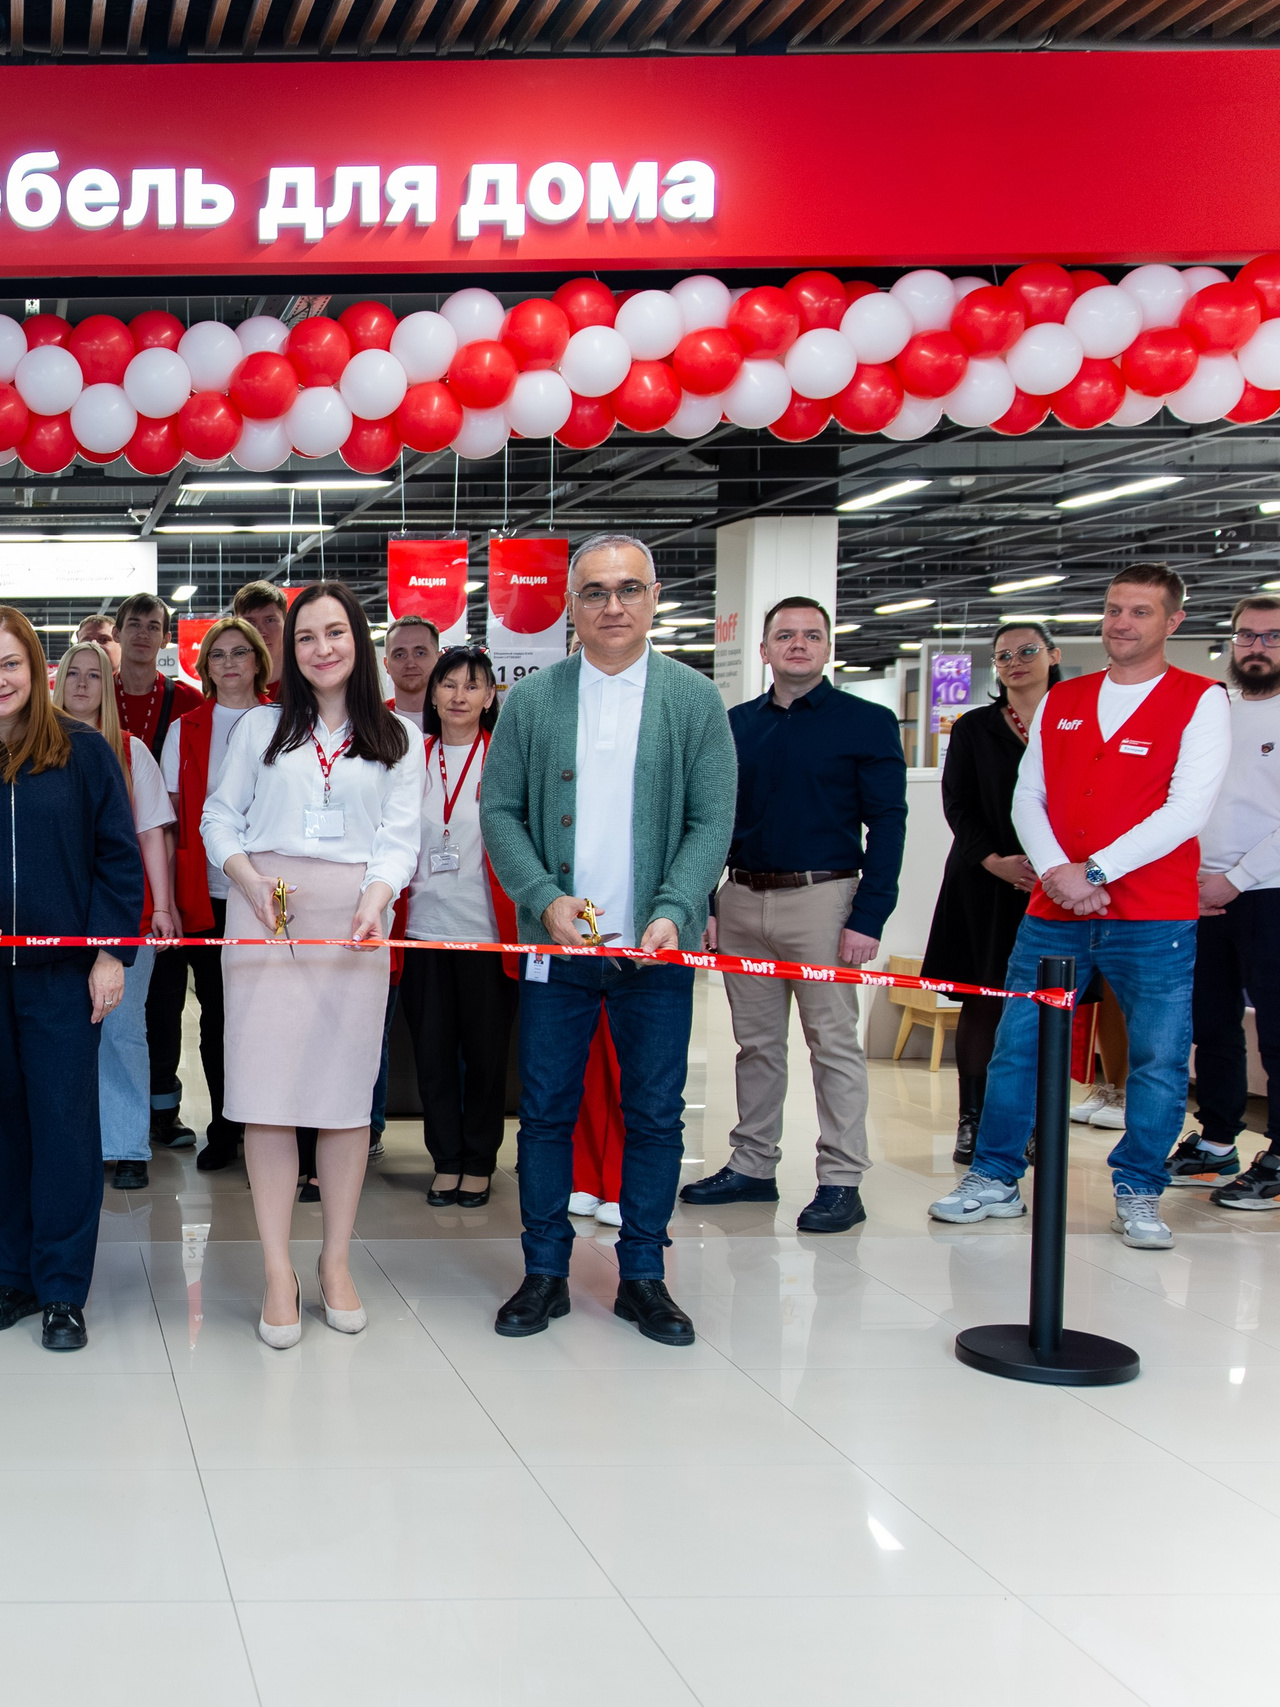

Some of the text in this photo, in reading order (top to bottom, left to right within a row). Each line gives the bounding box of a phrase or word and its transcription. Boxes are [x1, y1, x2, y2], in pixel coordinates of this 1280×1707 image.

[257, 164, 438, 245] для
[457, 158, 716, 241] дома
[408, 575, 447, 588] Акция
[510, 574, 548, 587] Акция
[1056, 718, 1084, 731] Hoff
[26, 937, 61, 946] Hoff
[86, 937, 121, 946] Hoff
[443, 942, 479, 950] Hoff
[502, 944, 538, 952] Hoff
[561, 946, 597, 955] Hoff
[681, 953, 717, 968] Hoff
[740, 959, 777, 975] Hoff
[800, 966, 836, 982] Hoff
